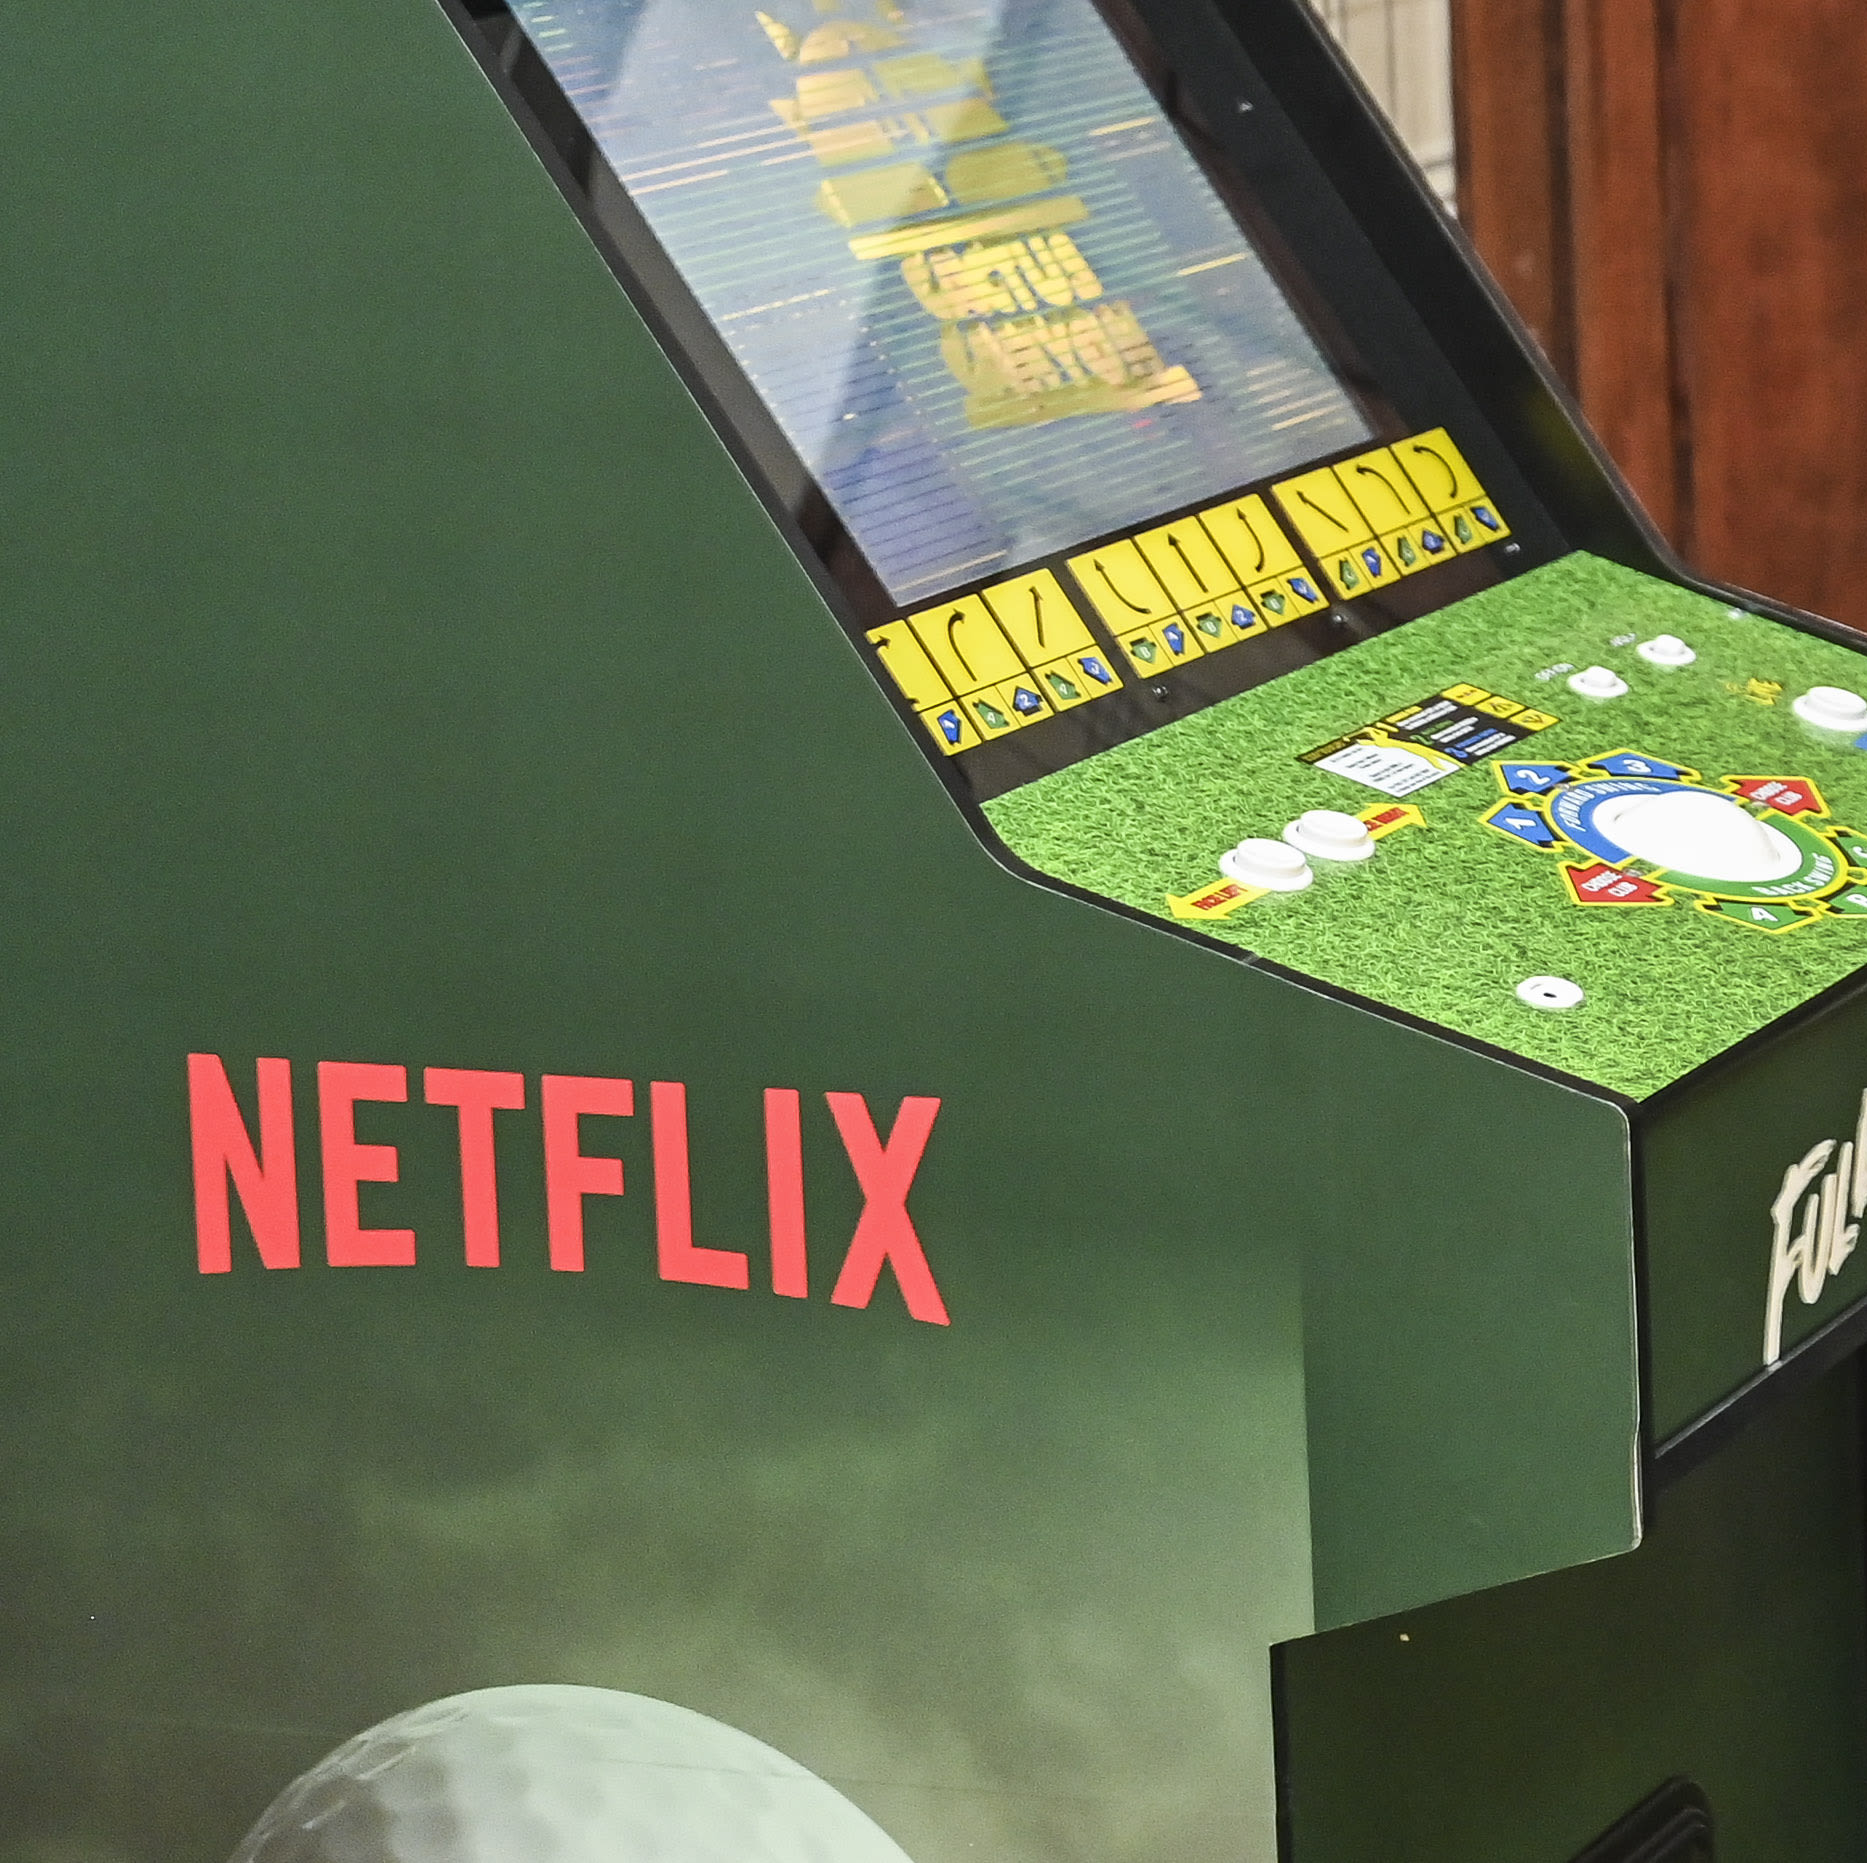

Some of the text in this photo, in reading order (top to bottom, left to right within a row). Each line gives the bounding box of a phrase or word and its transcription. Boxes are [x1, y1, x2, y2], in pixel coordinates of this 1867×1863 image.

[1623, 759, 1652, 774] 3
[1516, 769, 1550, 785] 2
[1503, 815, 1537, 830] 1
[1750, 906, 1779, 923] A
[186, 1052, 952, 1327] NETFLIX
